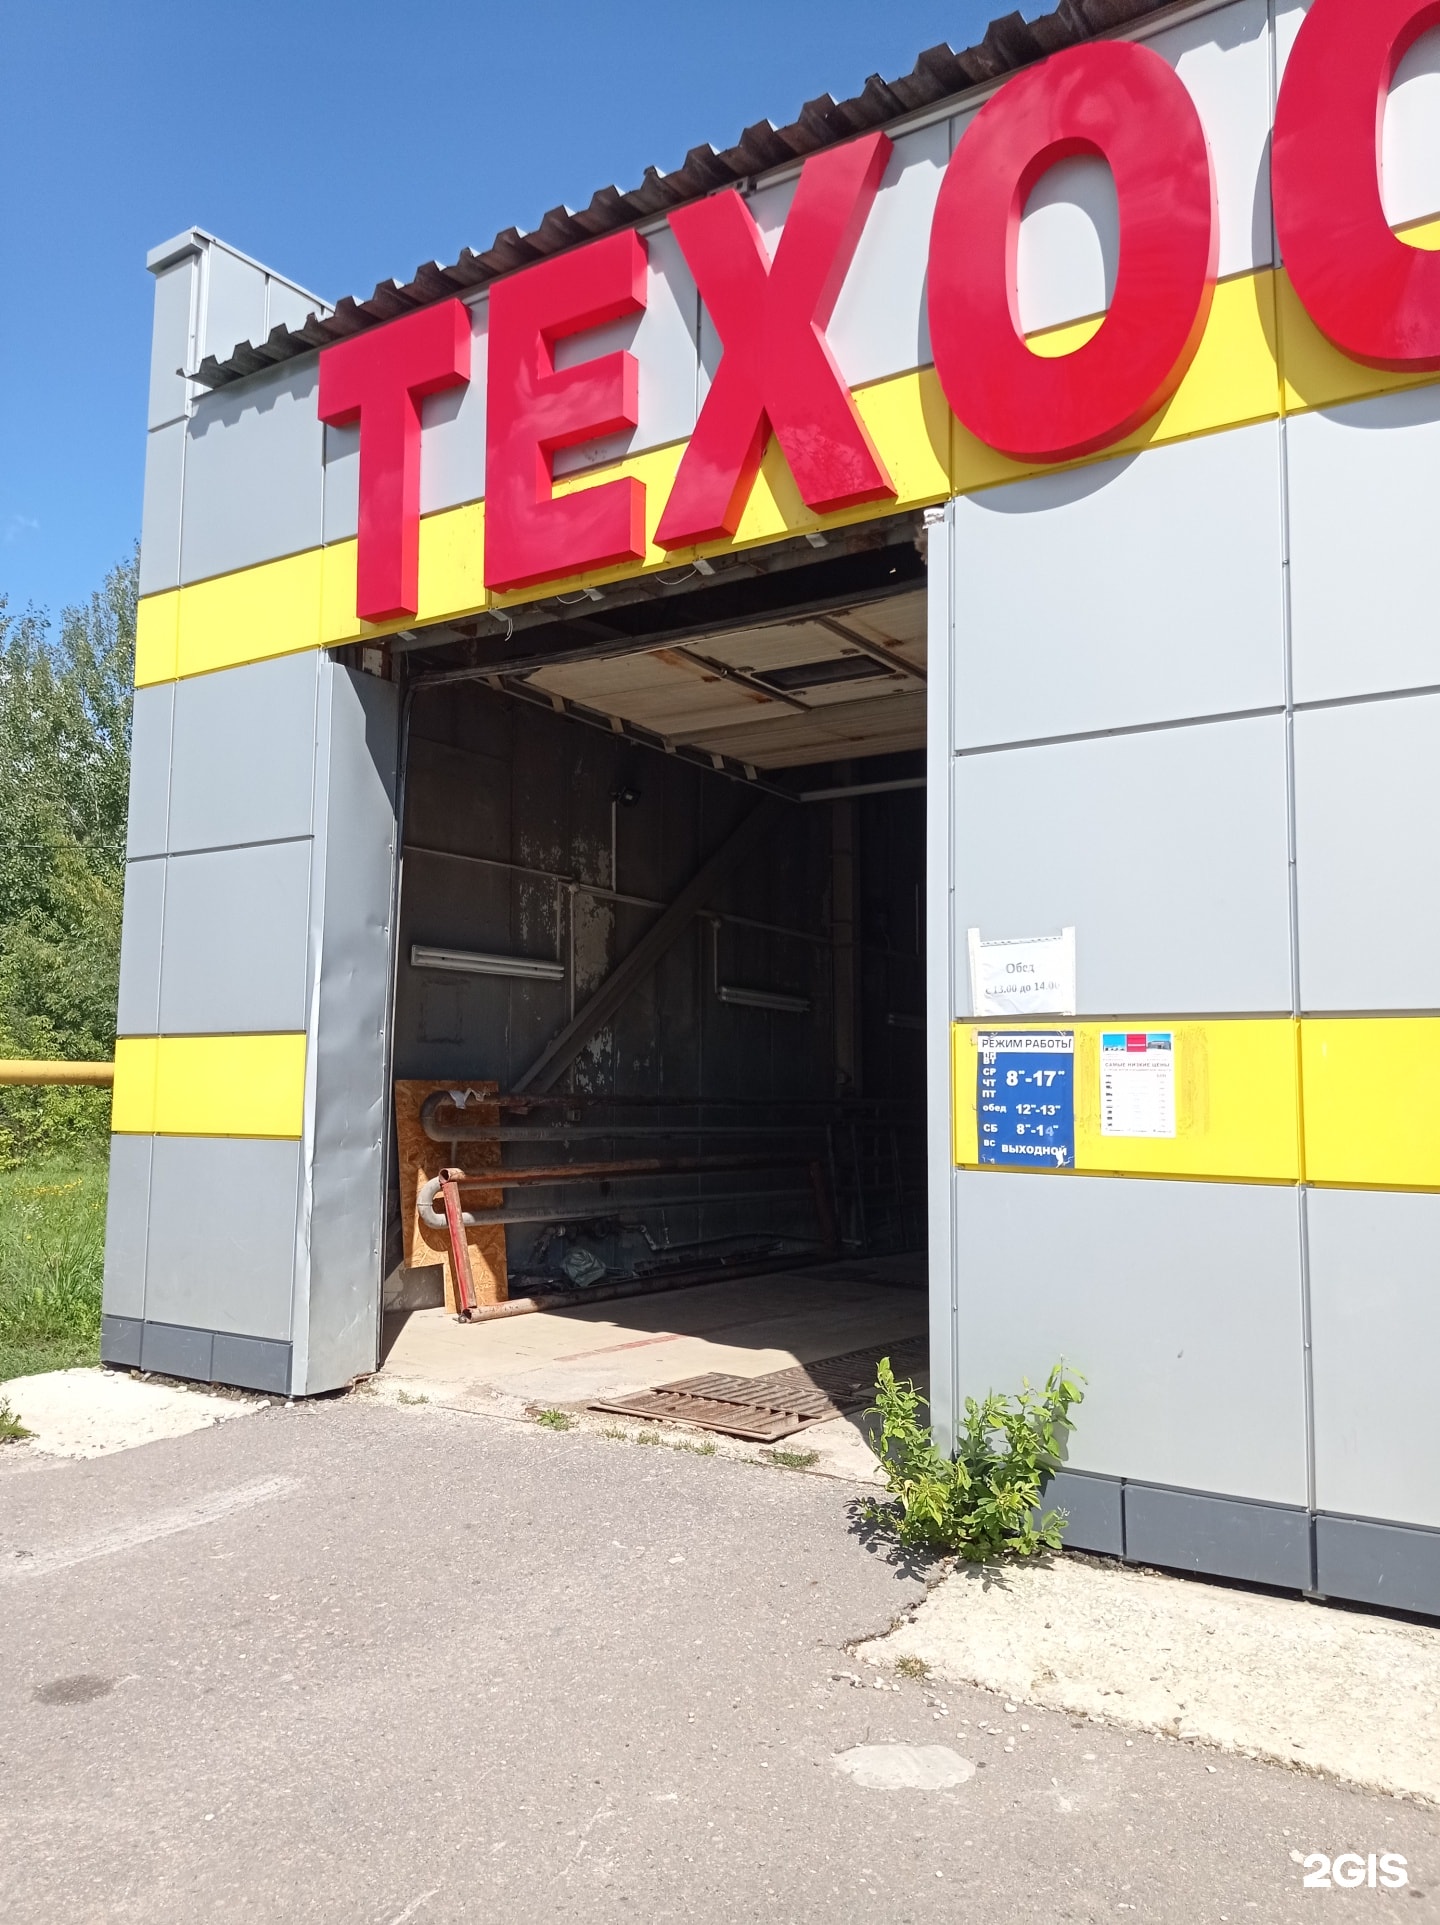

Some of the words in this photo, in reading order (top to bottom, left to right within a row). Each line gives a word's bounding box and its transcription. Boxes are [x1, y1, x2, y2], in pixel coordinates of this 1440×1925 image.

[1006, 962, 1035, 974] Обед
[1019, 985, 1031, 994] до
[982, 1039, 1023, 1048] РЕЖИМ
[1025, 1039, 1072, 1048] РАБОТЫ
[983, 1057, 996, 1065] ВТ
[983, 1068, 997, 1076] СР
[983, 1079, 997, 1087] ЧТ
[982, 1090, 997, 1098] ПТ
[982, 1104, 1007, 1113] обед
[983, 1124, 998, 1132] СБ
